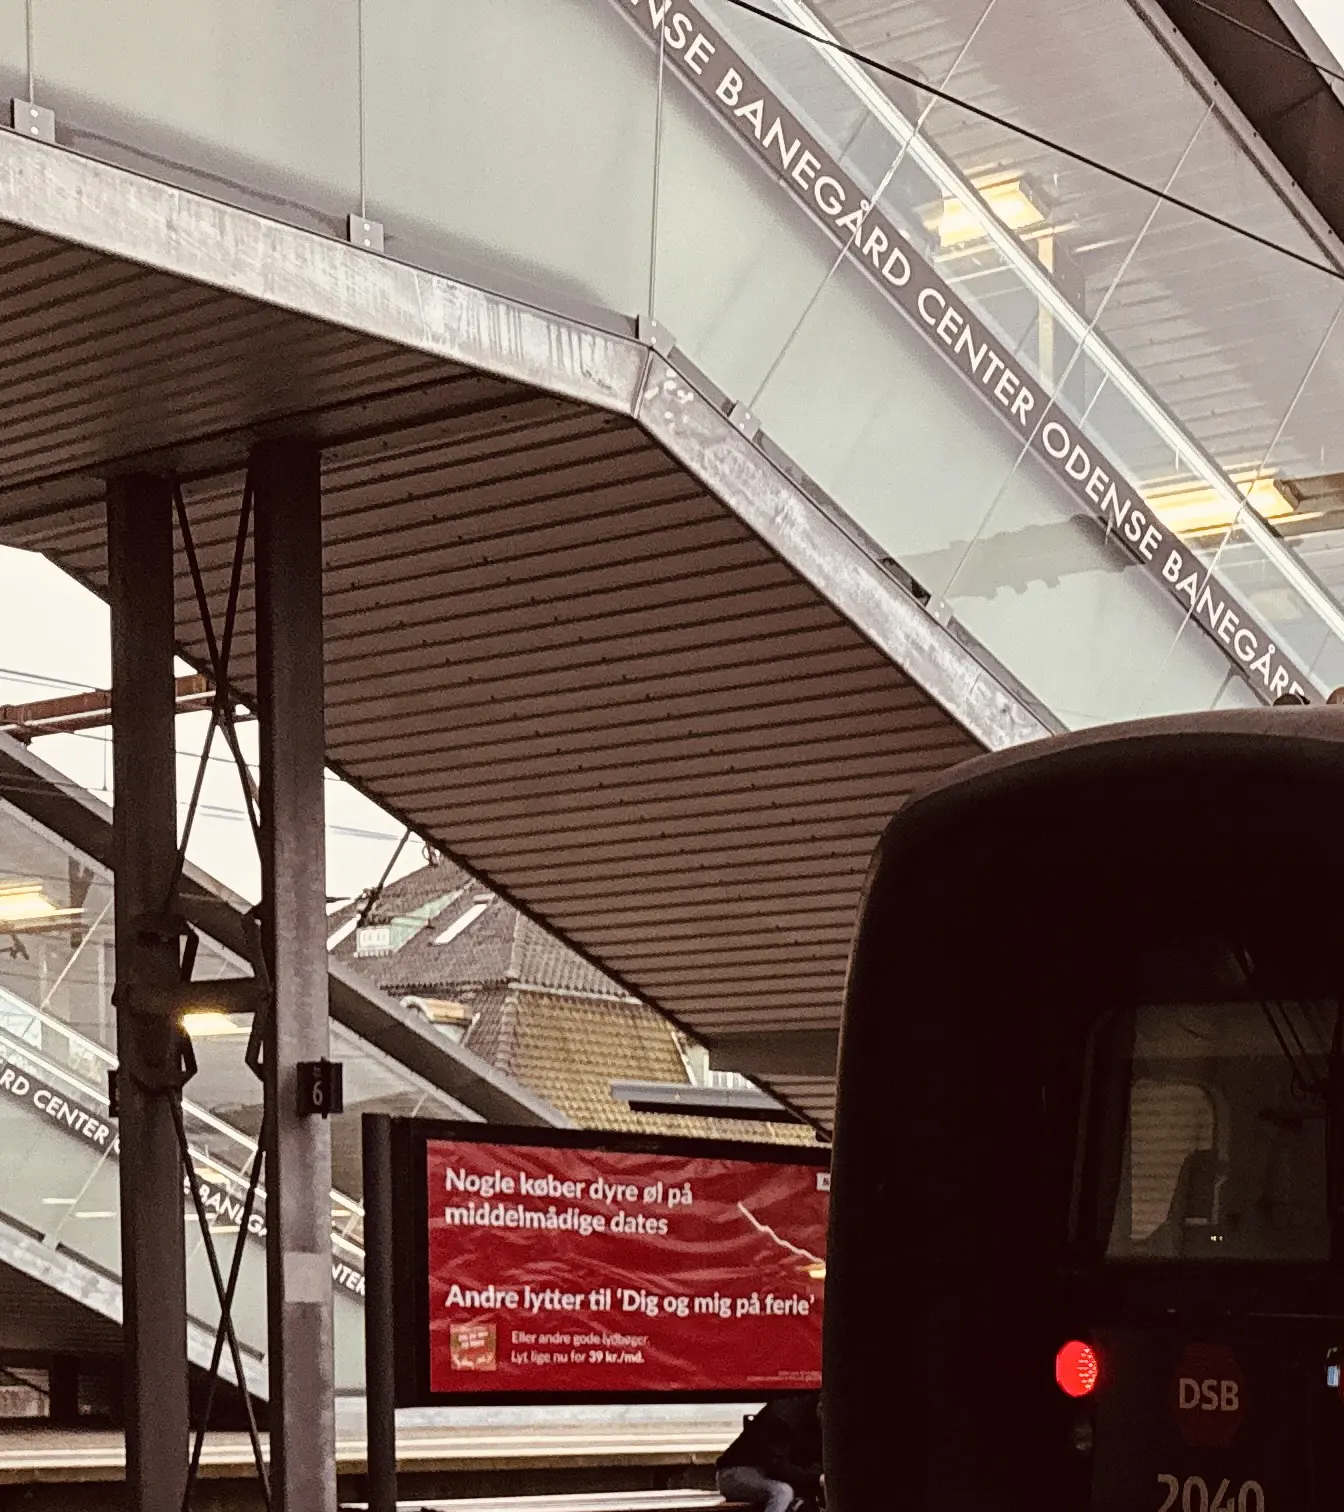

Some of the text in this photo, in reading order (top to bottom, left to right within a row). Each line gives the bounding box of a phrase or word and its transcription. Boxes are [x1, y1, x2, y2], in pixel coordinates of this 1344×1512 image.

[631, 0, 717, 75] NSE
[715, 67, 911, 286] BANEGÅRD
[917, 288, 1036, 426] CENTER
[1042, 421, 1163, 560] ODENSE
[0, 1067, 110, 1146] RD CENTER
[312, 1080, 324, 1106] 6
[445, 1167, 693, 1208] Nogle køber dyre øl på
[444, 1203, 669, 1236] middelmådige dates
[444, 1284, 518, 1310] Andre
[523, 1287, 584, 1315] lytter
[588, 1288, 611, 1311] til
[663, 1295, 690, 1317] og
[694, 1291, 732, 1318] mig
[735, 1291, 760, 1318] på
[511, 1330, 537, 1344] Eller
[538, 1332, 571, 1345] andre
[573, 1334, 601, 1347] gode
[511, 1350, 528, 1365] Lyt
[530, 1350, 551, 1365] lige
[553, 1353, 568, 1363] nu
[570, 1351, 586, 1363] for
[588, 1351, 603, 1363] 39
[1179, 1377, 1239, 1412] DSB
